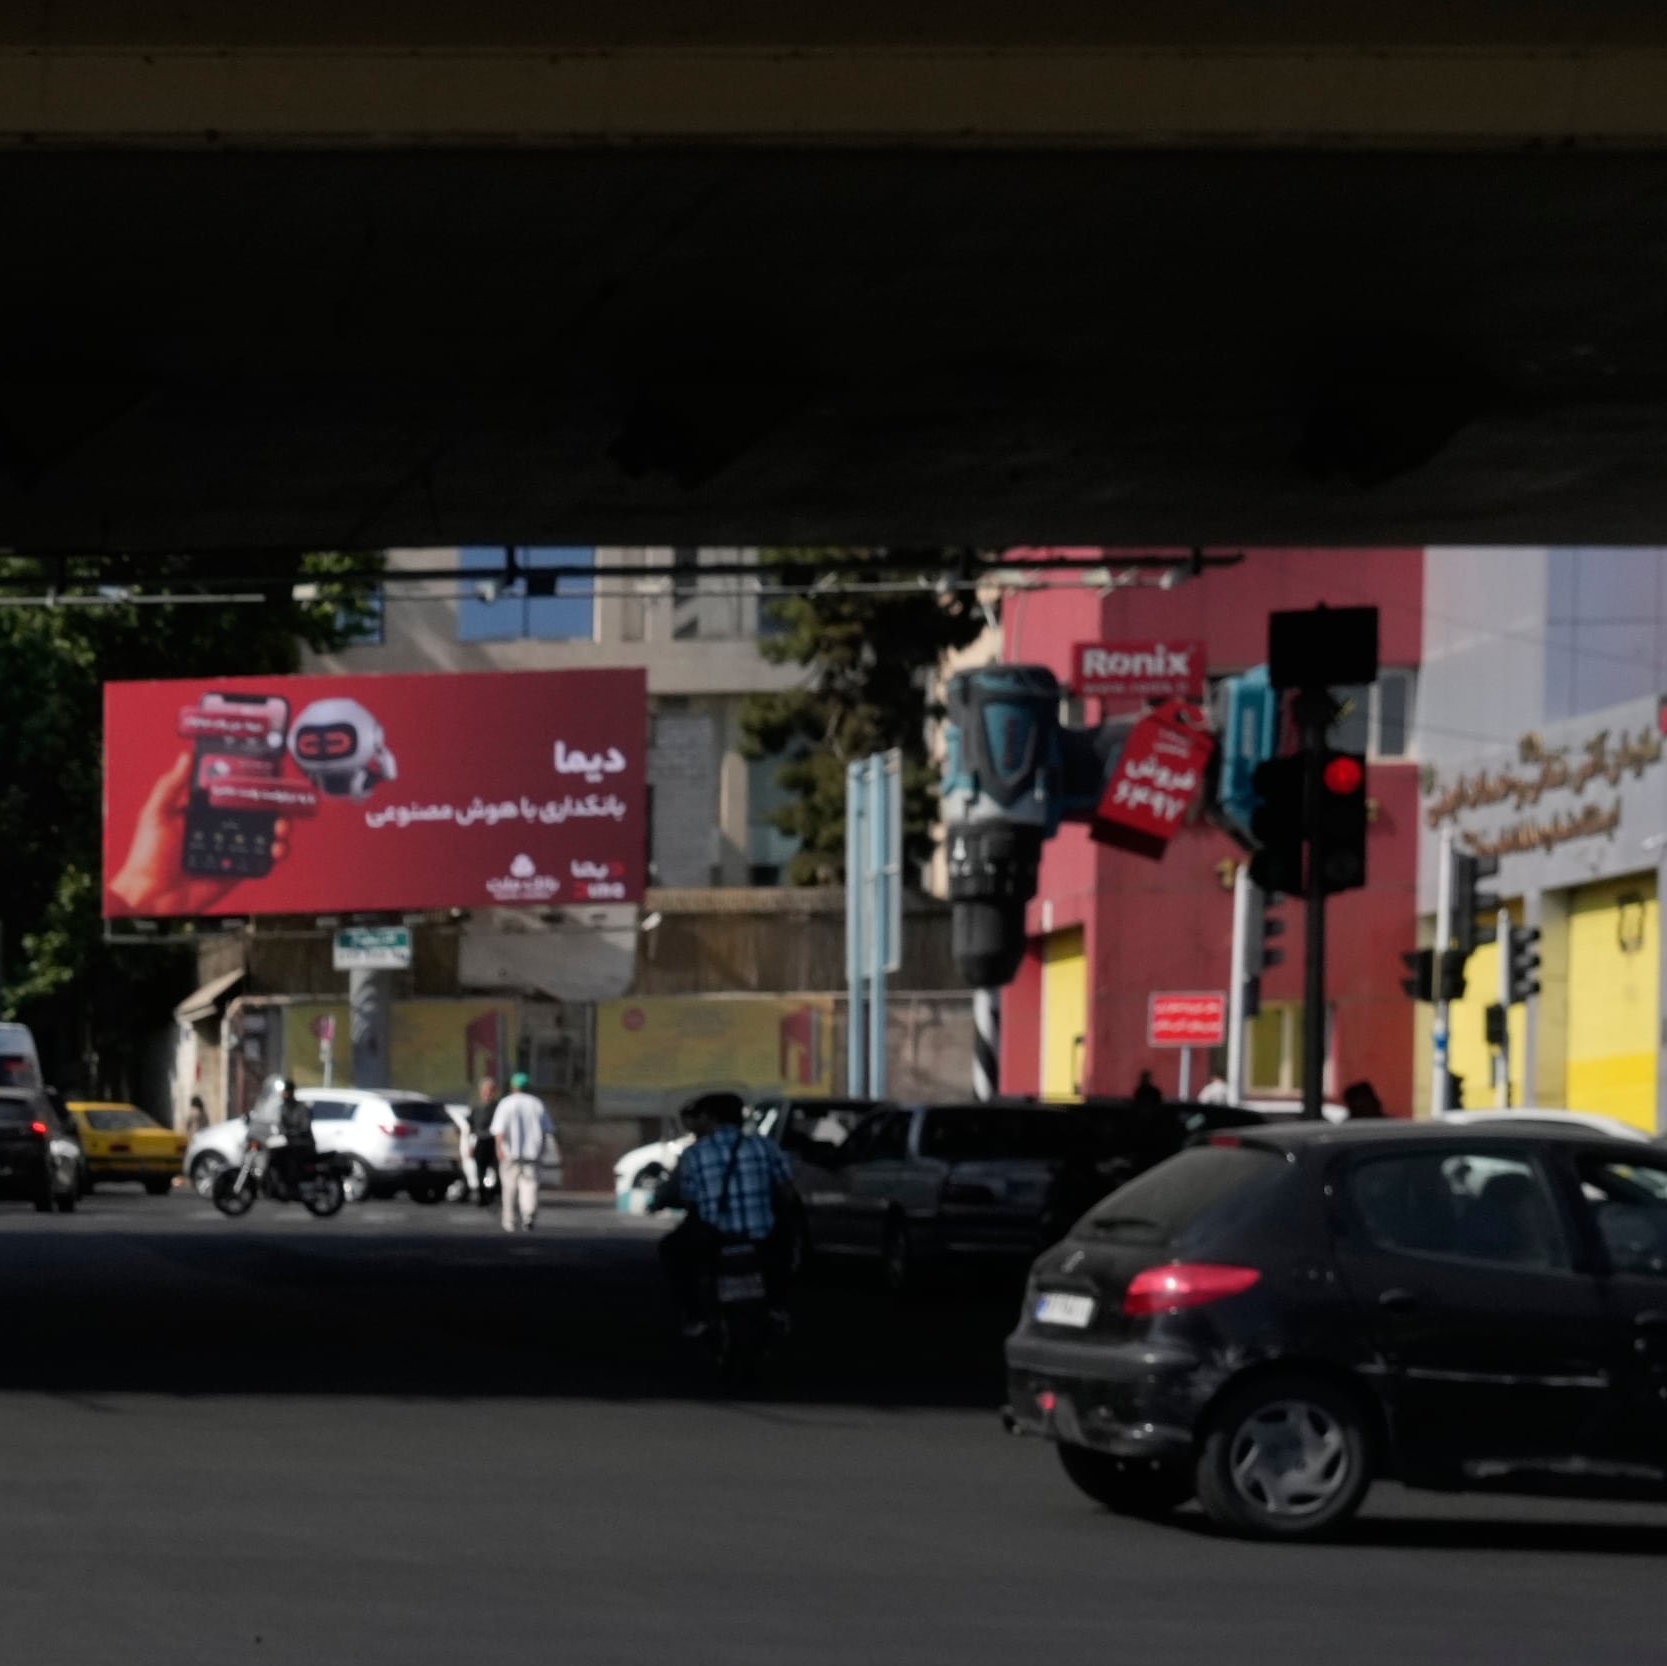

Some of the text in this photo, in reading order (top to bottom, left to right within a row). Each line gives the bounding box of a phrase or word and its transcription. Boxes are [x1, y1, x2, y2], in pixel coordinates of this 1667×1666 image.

[1082, 643, 1190, 678] Ronix
[554, 740, 627, 784] دیما
[1124, 755, 1196, 792] فروش
[365, 794, 627, 829] بانکداری با هوش مصنوعی
